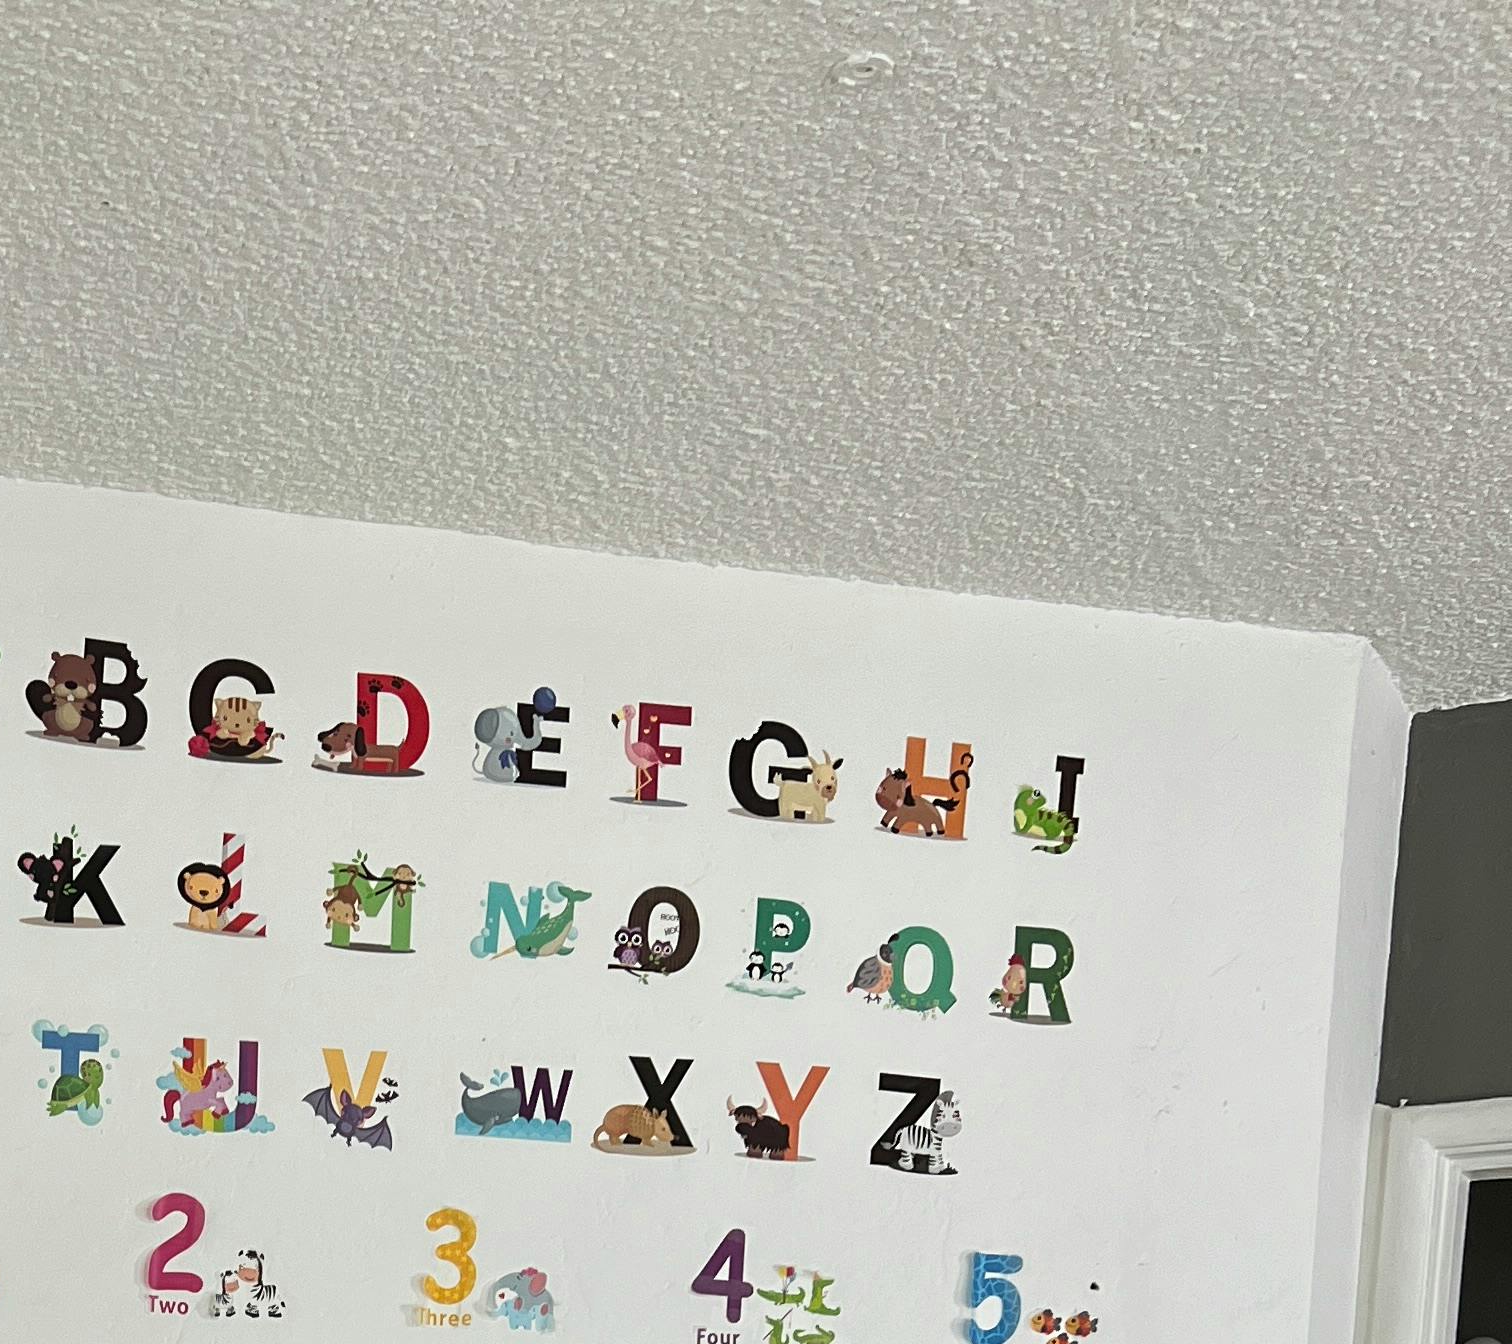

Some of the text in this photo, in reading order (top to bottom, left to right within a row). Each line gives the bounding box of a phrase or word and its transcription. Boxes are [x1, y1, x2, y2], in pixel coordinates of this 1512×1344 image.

[84, 637, 148, 747] B
[188, 658, 275, 758] C
[357, 672, 430, 772] D
[515, 702, 570, 788] E
[638, 701, 692, 801] F
[729, 721, 809, 820] G
[905, 736, 972, 839] H
[1052, 755, 1086, 834] I
[44, 837, 125, 925] K
[221, 833, 267, 937] L
[332, 862, 413, 950] M
[487, 881, 543, 953] N
[627, 886, 700, 972] O
[754, 897, 810, 978] P
[889, 926, 957, 1014] Q
[1010, 925, 1074, 1024] R
[42, 1031, 100, 1111] T
[183, 1038, 259, 1133] U
[322, 1048, 388, 1123] V
[511, 1065, 573, 1123] W
[623, 1056, 694, 1148] X
[755, 1061, 830, 1161] Y
[870, 1072, 945, 1174] Z
[147, 1193, 206, 1293] 2
[423, 1208, 477, 1304] 3
[692, 1229, 753, 1324] 4
[147, 1296, 190, 1316] Two
[415, 1308, 473, 1327] Three
